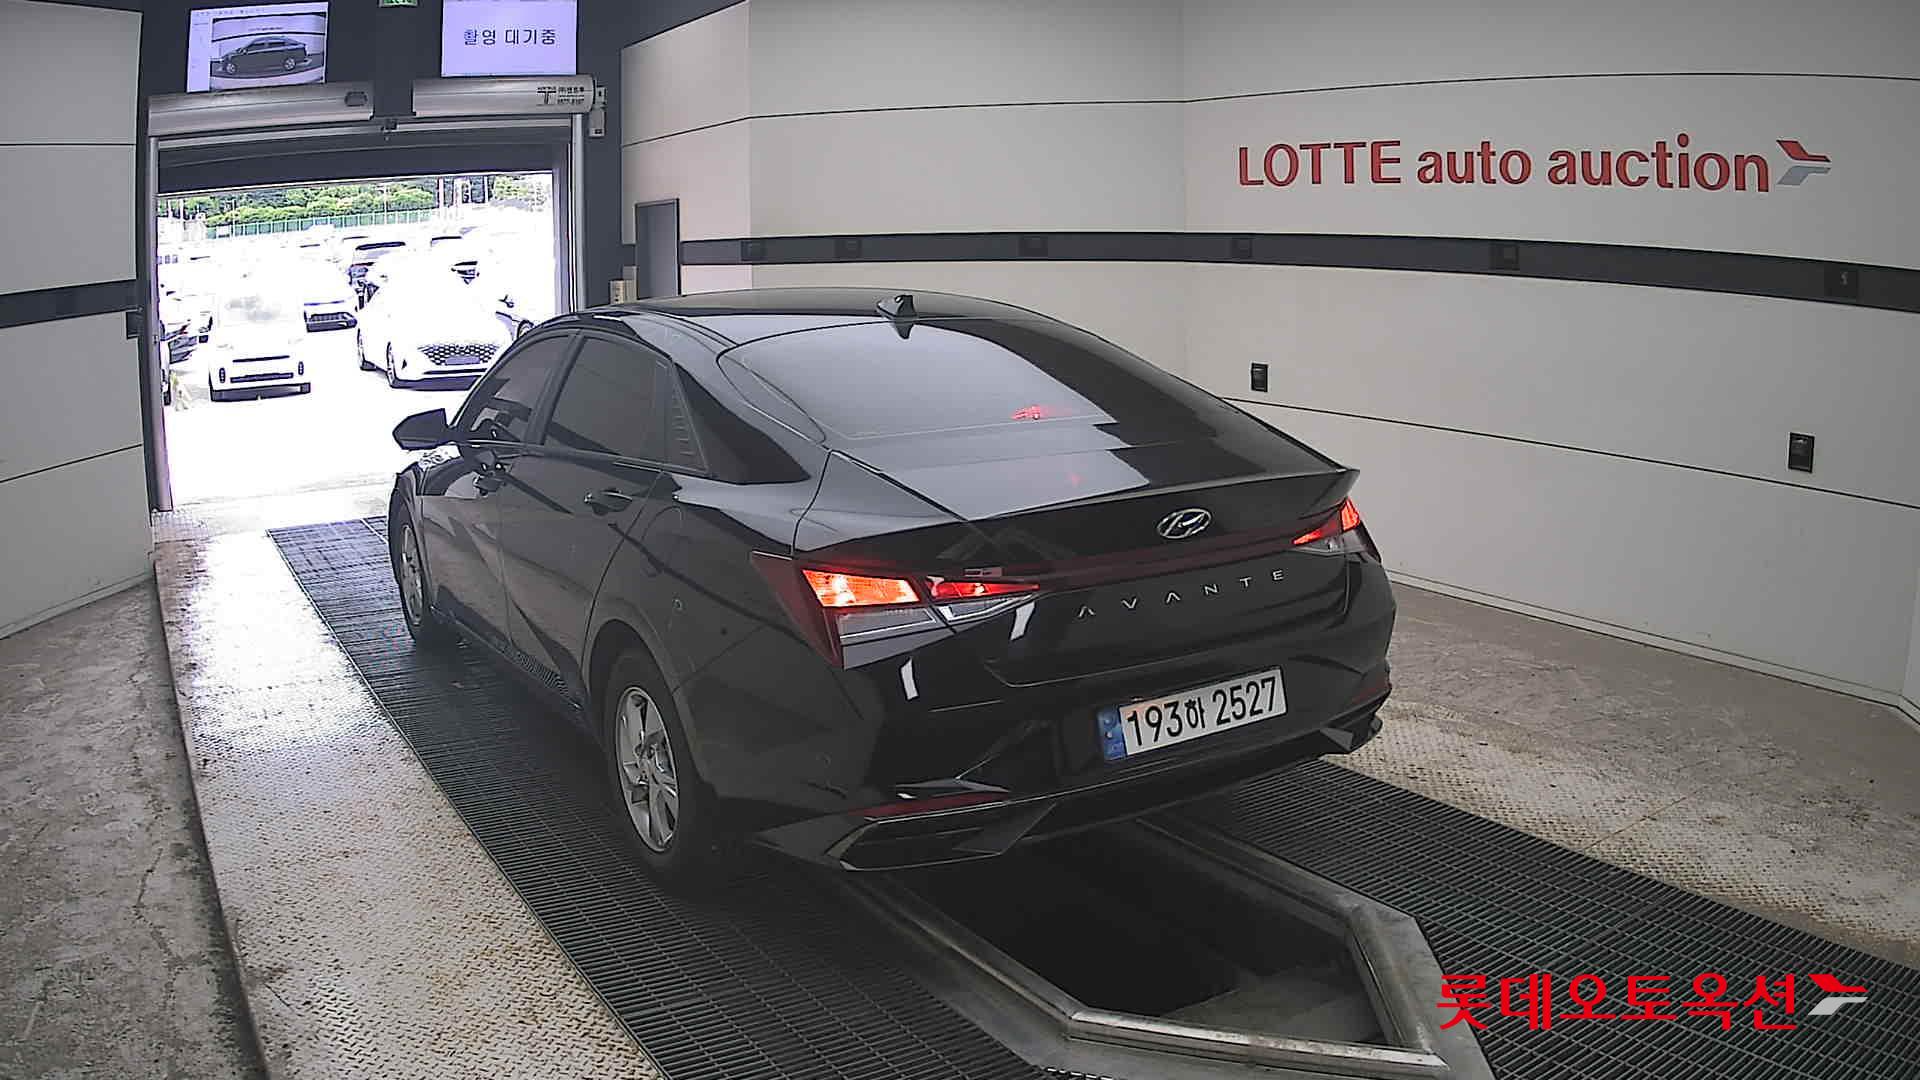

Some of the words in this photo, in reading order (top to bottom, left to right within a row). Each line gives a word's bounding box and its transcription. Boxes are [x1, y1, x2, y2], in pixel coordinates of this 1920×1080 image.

[504, 28, 556, 46] 대기중
[1238, 140, 1401, 188] LOTTE
[1417, 141, 1533, 185] auto
[1548, 134, 1770, 192] auction
[1077, 568, 1285, 619] AVANTE
[1127, 697, 1206, 746] 193하
[1212, 676, 1277, 726] 2527
